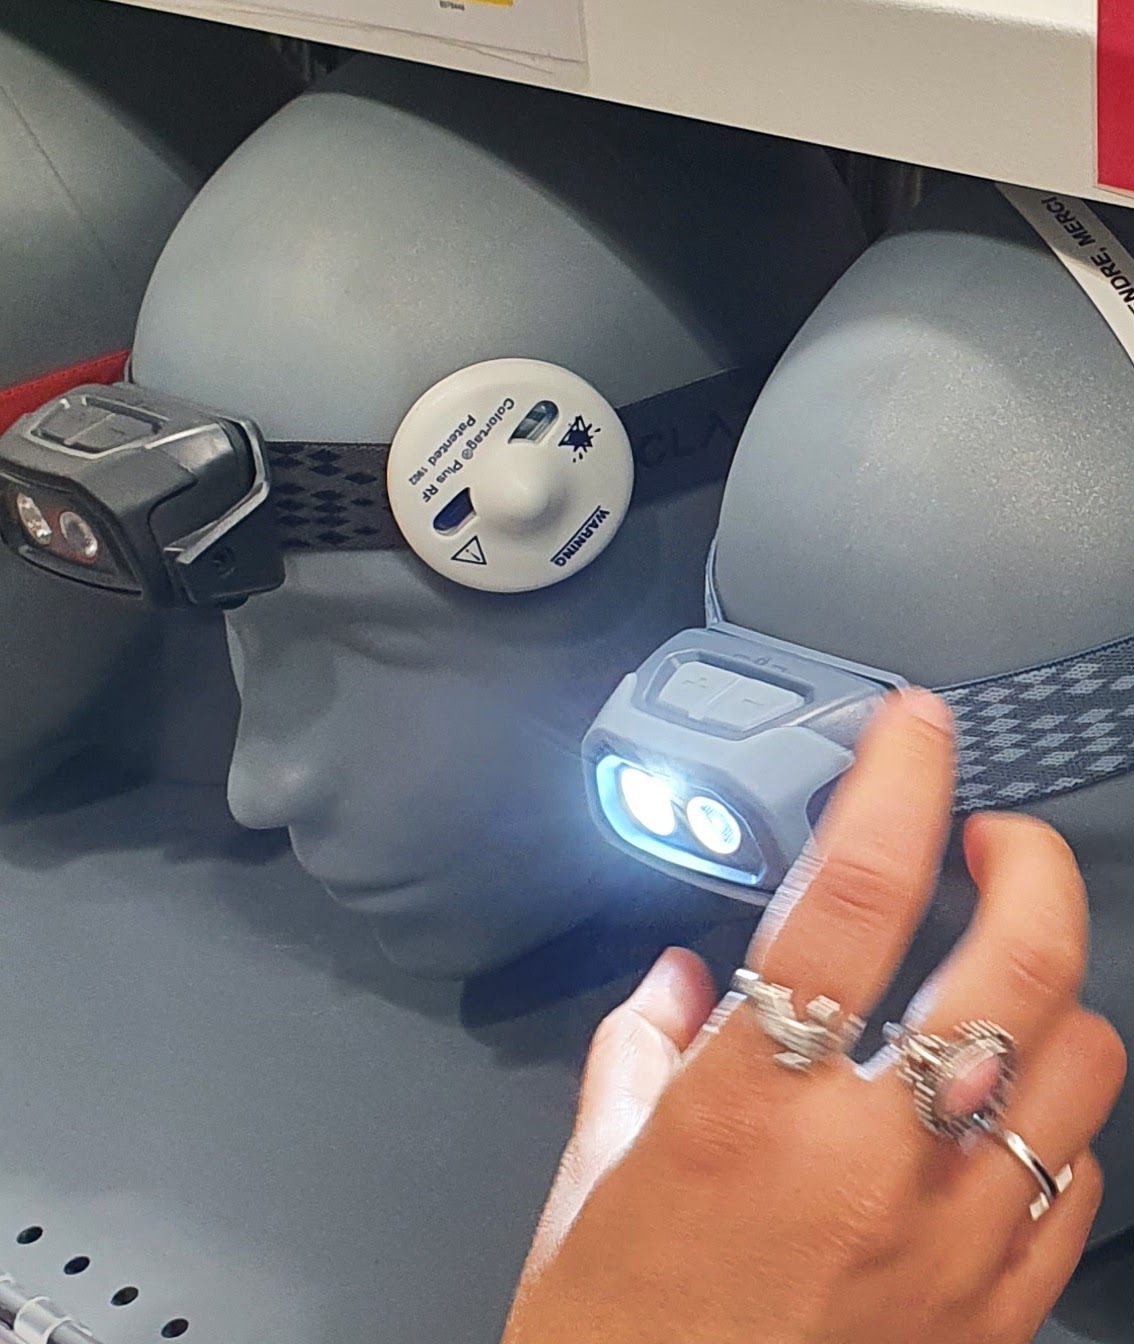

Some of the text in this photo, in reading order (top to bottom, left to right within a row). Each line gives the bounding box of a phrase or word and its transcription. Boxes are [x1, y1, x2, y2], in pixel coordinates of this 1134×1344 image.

[1041, 196, 1097, 247] MERCI
[428, 414, 477, 467] Patented
[422, 484, 439, 503] RF
[436, 459, 463, 484] Plus
[553, 508, 611, 568] WARNING
